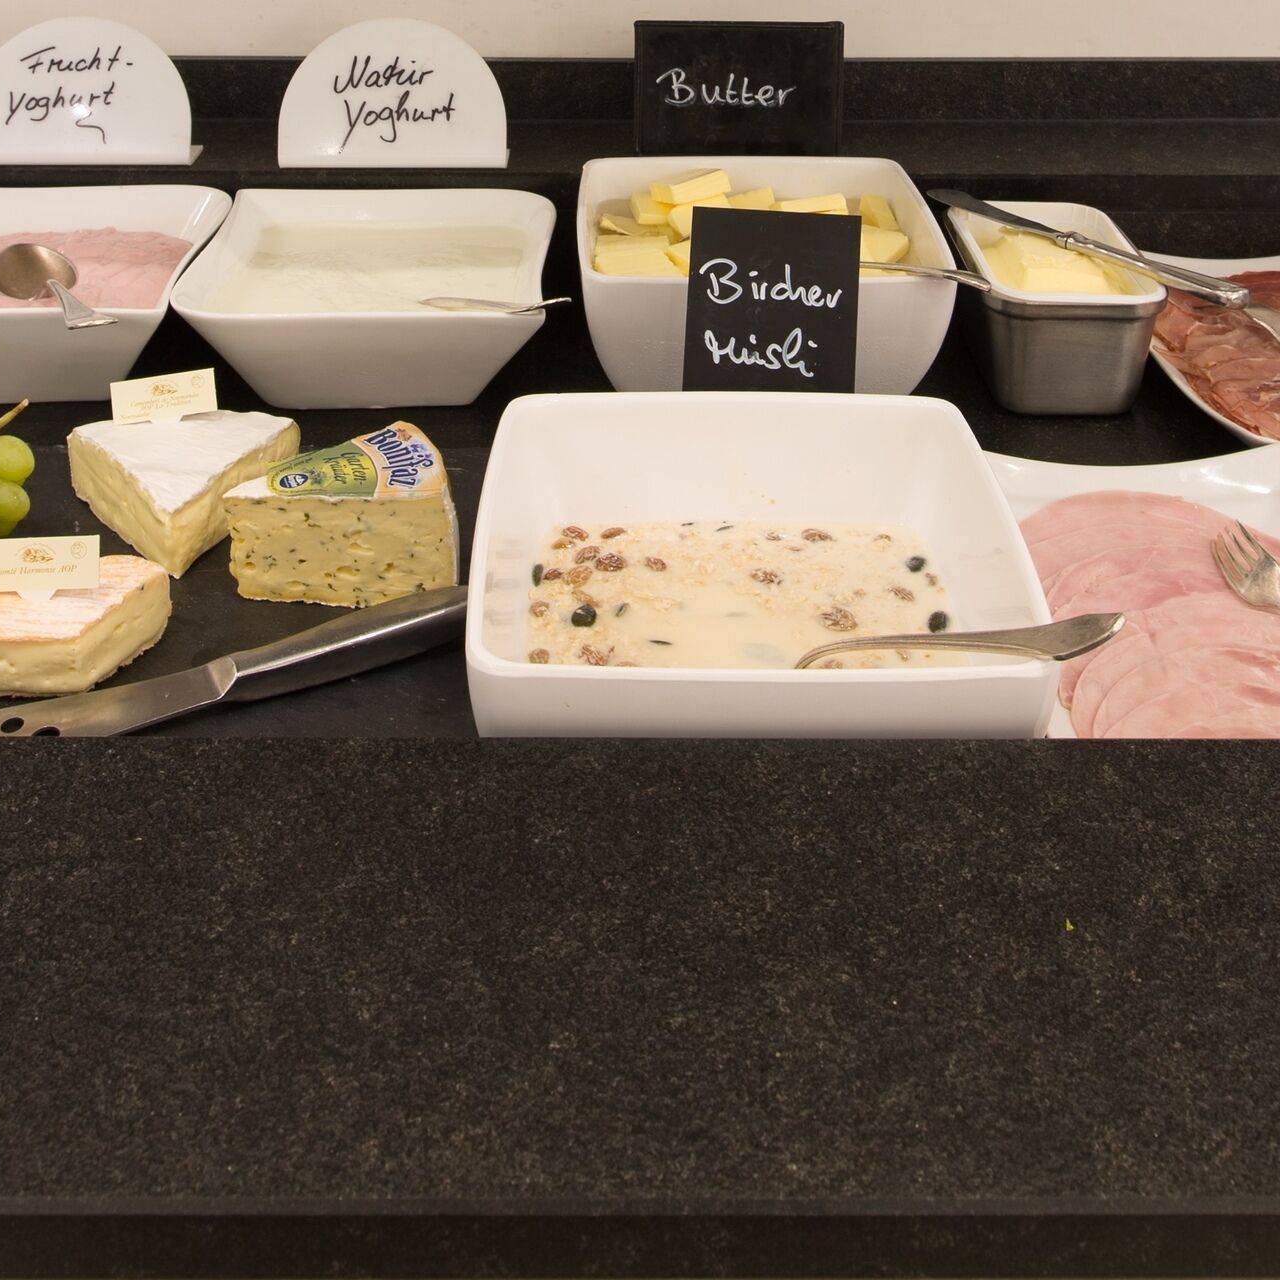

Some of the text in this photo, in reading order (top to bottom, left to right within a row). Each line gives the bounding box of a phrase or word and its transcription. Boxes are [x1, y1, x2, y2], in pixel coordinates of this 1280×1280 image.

[655, 67, 796, 108] Butter
[699, 257, 843, 309] Bircher
[363, 428, 434, 488] Bonifaz
